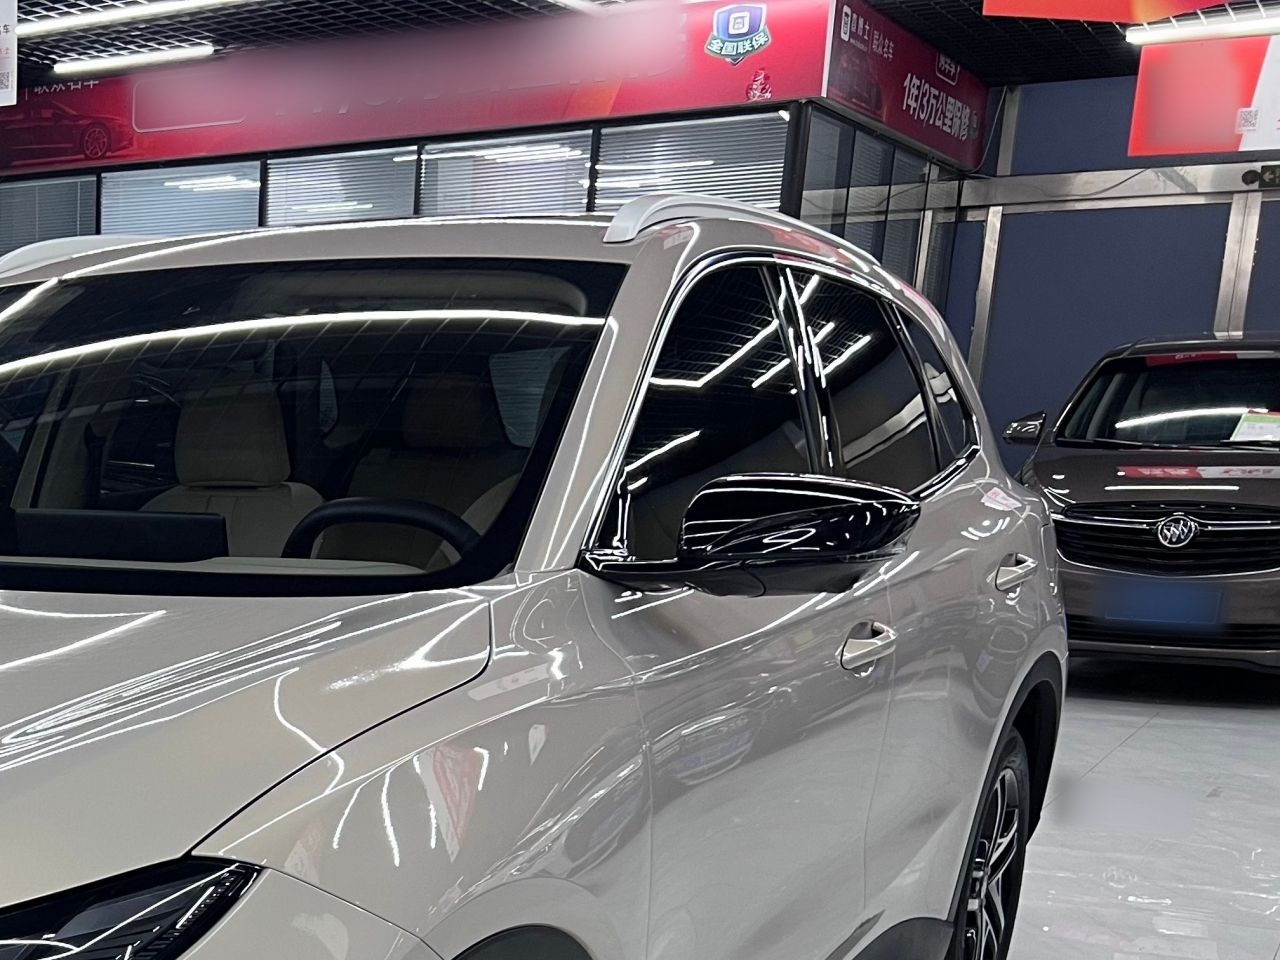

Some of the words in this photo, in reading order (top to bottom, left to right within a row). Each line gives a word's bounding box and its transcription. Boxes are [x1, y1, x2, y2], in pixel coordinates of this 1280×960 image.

[707, 31, 769, 56] 全国联保
[902, 72, 970, 142] 1年/3万公里保修
